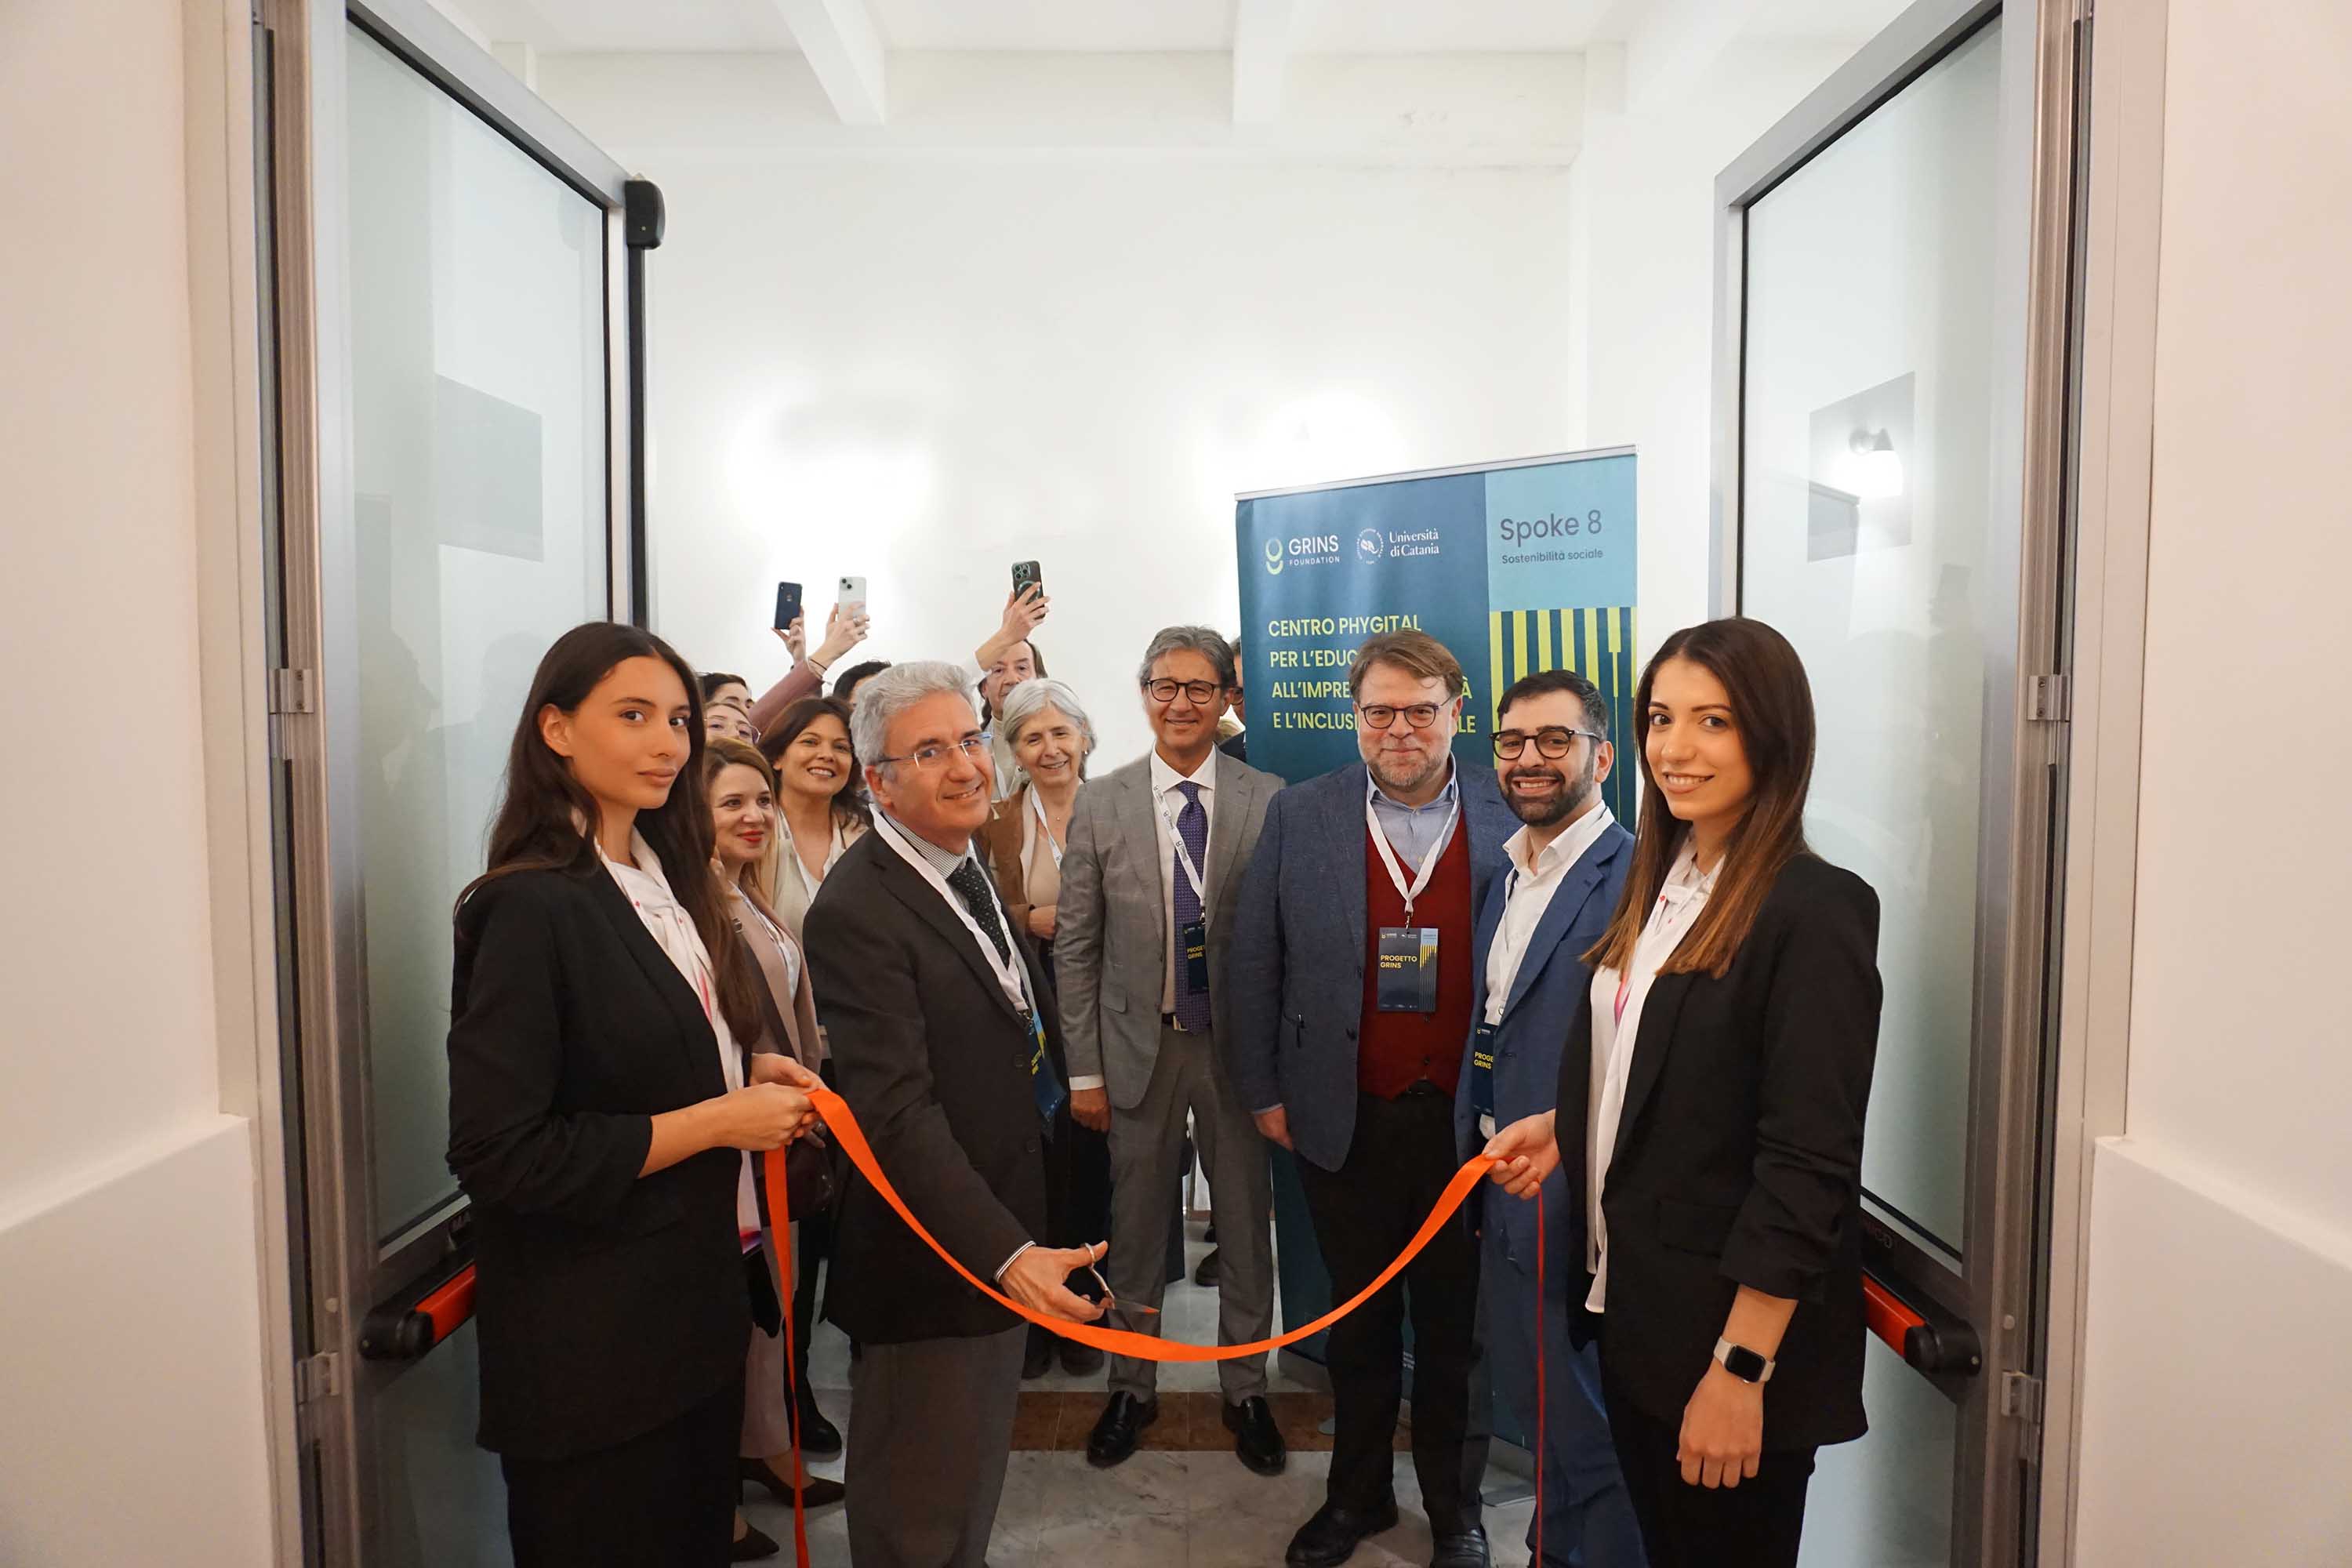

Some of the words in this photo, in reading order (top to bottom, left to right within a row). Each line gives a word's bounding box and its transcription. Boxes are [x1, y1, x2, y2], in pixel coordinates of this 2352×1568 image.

[1389, 528, 1439, 543] Università
[1501, 513, 1579, 547] Spoke
[1588, 510, 1602, 534] 8
[1289, 535, 1339, 555] GRINS
[1390, 546, 1399, 557] di
[1401, 543, 1439, 557] Catania
[1290, 556, 1340, 566] FOUNDATION
[1502, 550, 1565, 564] Sostenibilità
[1568, 548, 1603, 560] sociale
[1269, 618, 1334, 637] CENTRO
[1339, 615, 1421, 634] PHYGITAL
[1270, 651, 1298, 667] PER
[1302, 649, 1358, 667] L'EDUC
[1272, 681, 1352, 699] ALL'IMPRE
[1273, 712, 1281, 728] E
[1286, 712, 1359, 730] L'INCLUSI
[1474, 1059, 1491, 1069] GRINS
[1475, 1051, 1494, 1062] PROGE
